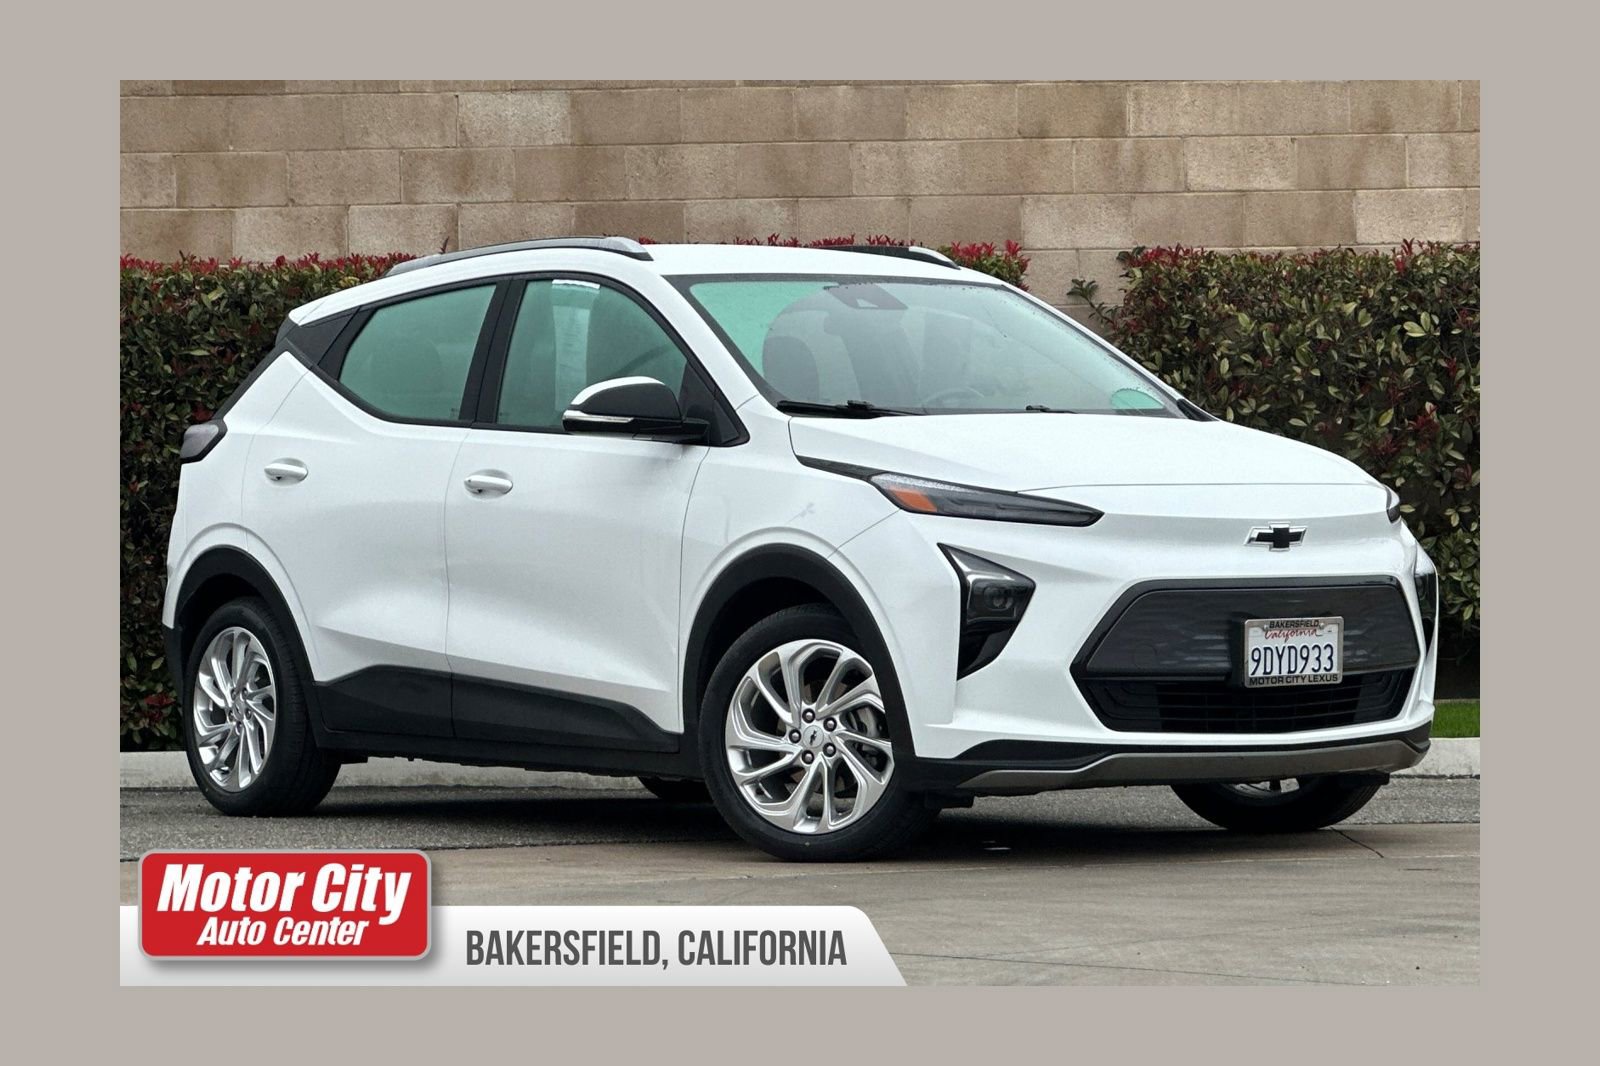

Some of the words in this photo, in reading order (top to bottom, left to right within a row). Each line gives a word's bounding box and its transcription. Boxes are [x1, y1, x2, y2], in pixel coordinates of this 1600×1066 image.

[1269, 620, 1320, 629] BAKERSFIELD
[1265, 629, 1323, 642] California
[1251, 643, 1334, 676] 9DYD933
[1249, 676, 1284, 686] MOTOR
[1286, 675, 1307, 684] CITY
[1308, 674, 1338, 683] LEXUS
